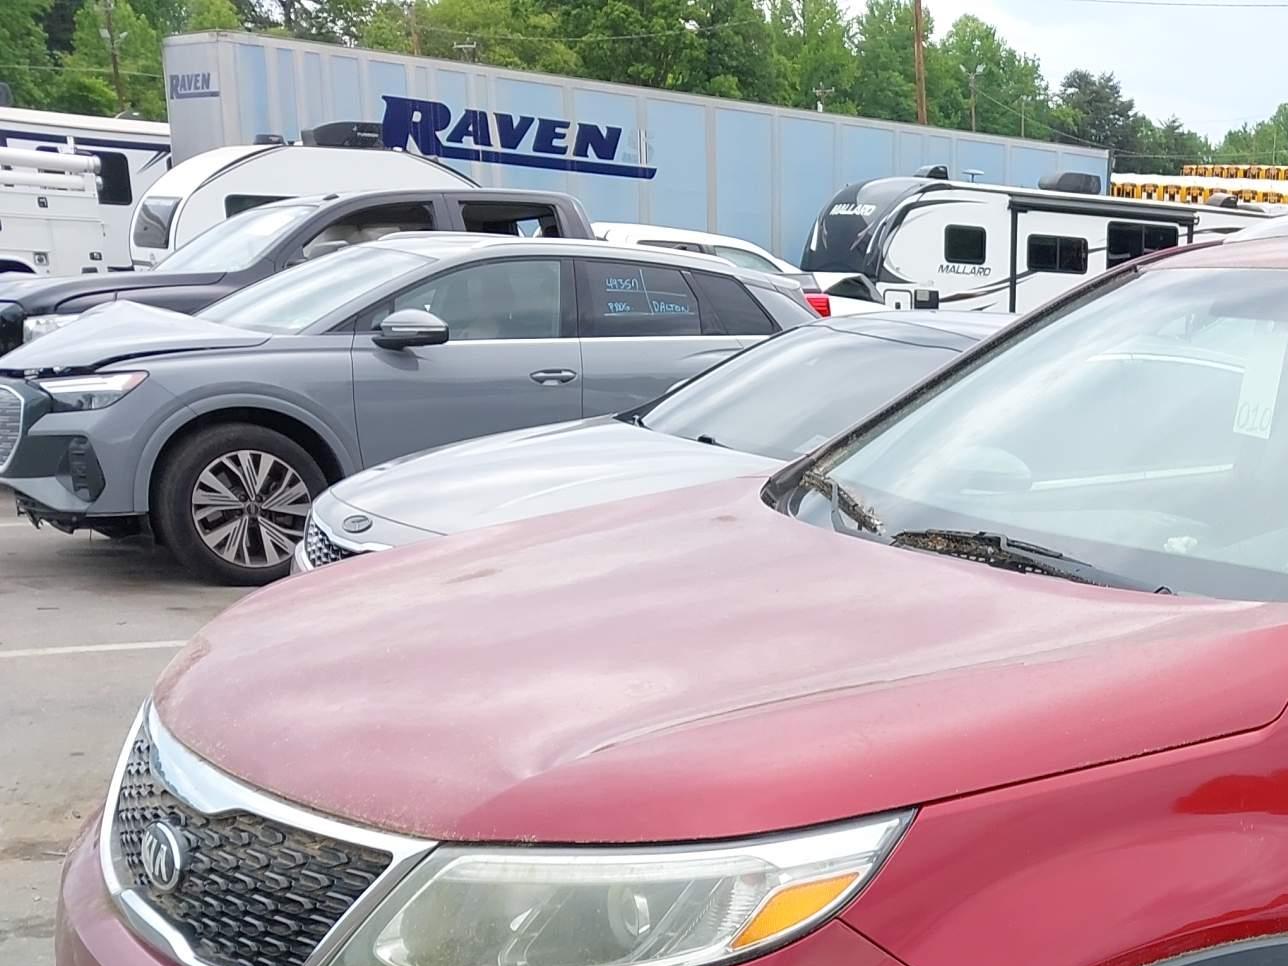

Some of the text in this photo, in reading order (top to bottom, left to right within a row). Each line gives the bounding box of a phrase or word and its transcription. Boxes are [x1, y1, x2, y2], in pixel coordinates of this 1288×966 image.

[169, 72, 211, 99] RAVEN
[382, 96, 622, 161] RAVEN
[829, 204, 876, 216] MALLARD
[938, 264, 992, 277] MALLARD
[652, 300, 690, 313] DALTON
